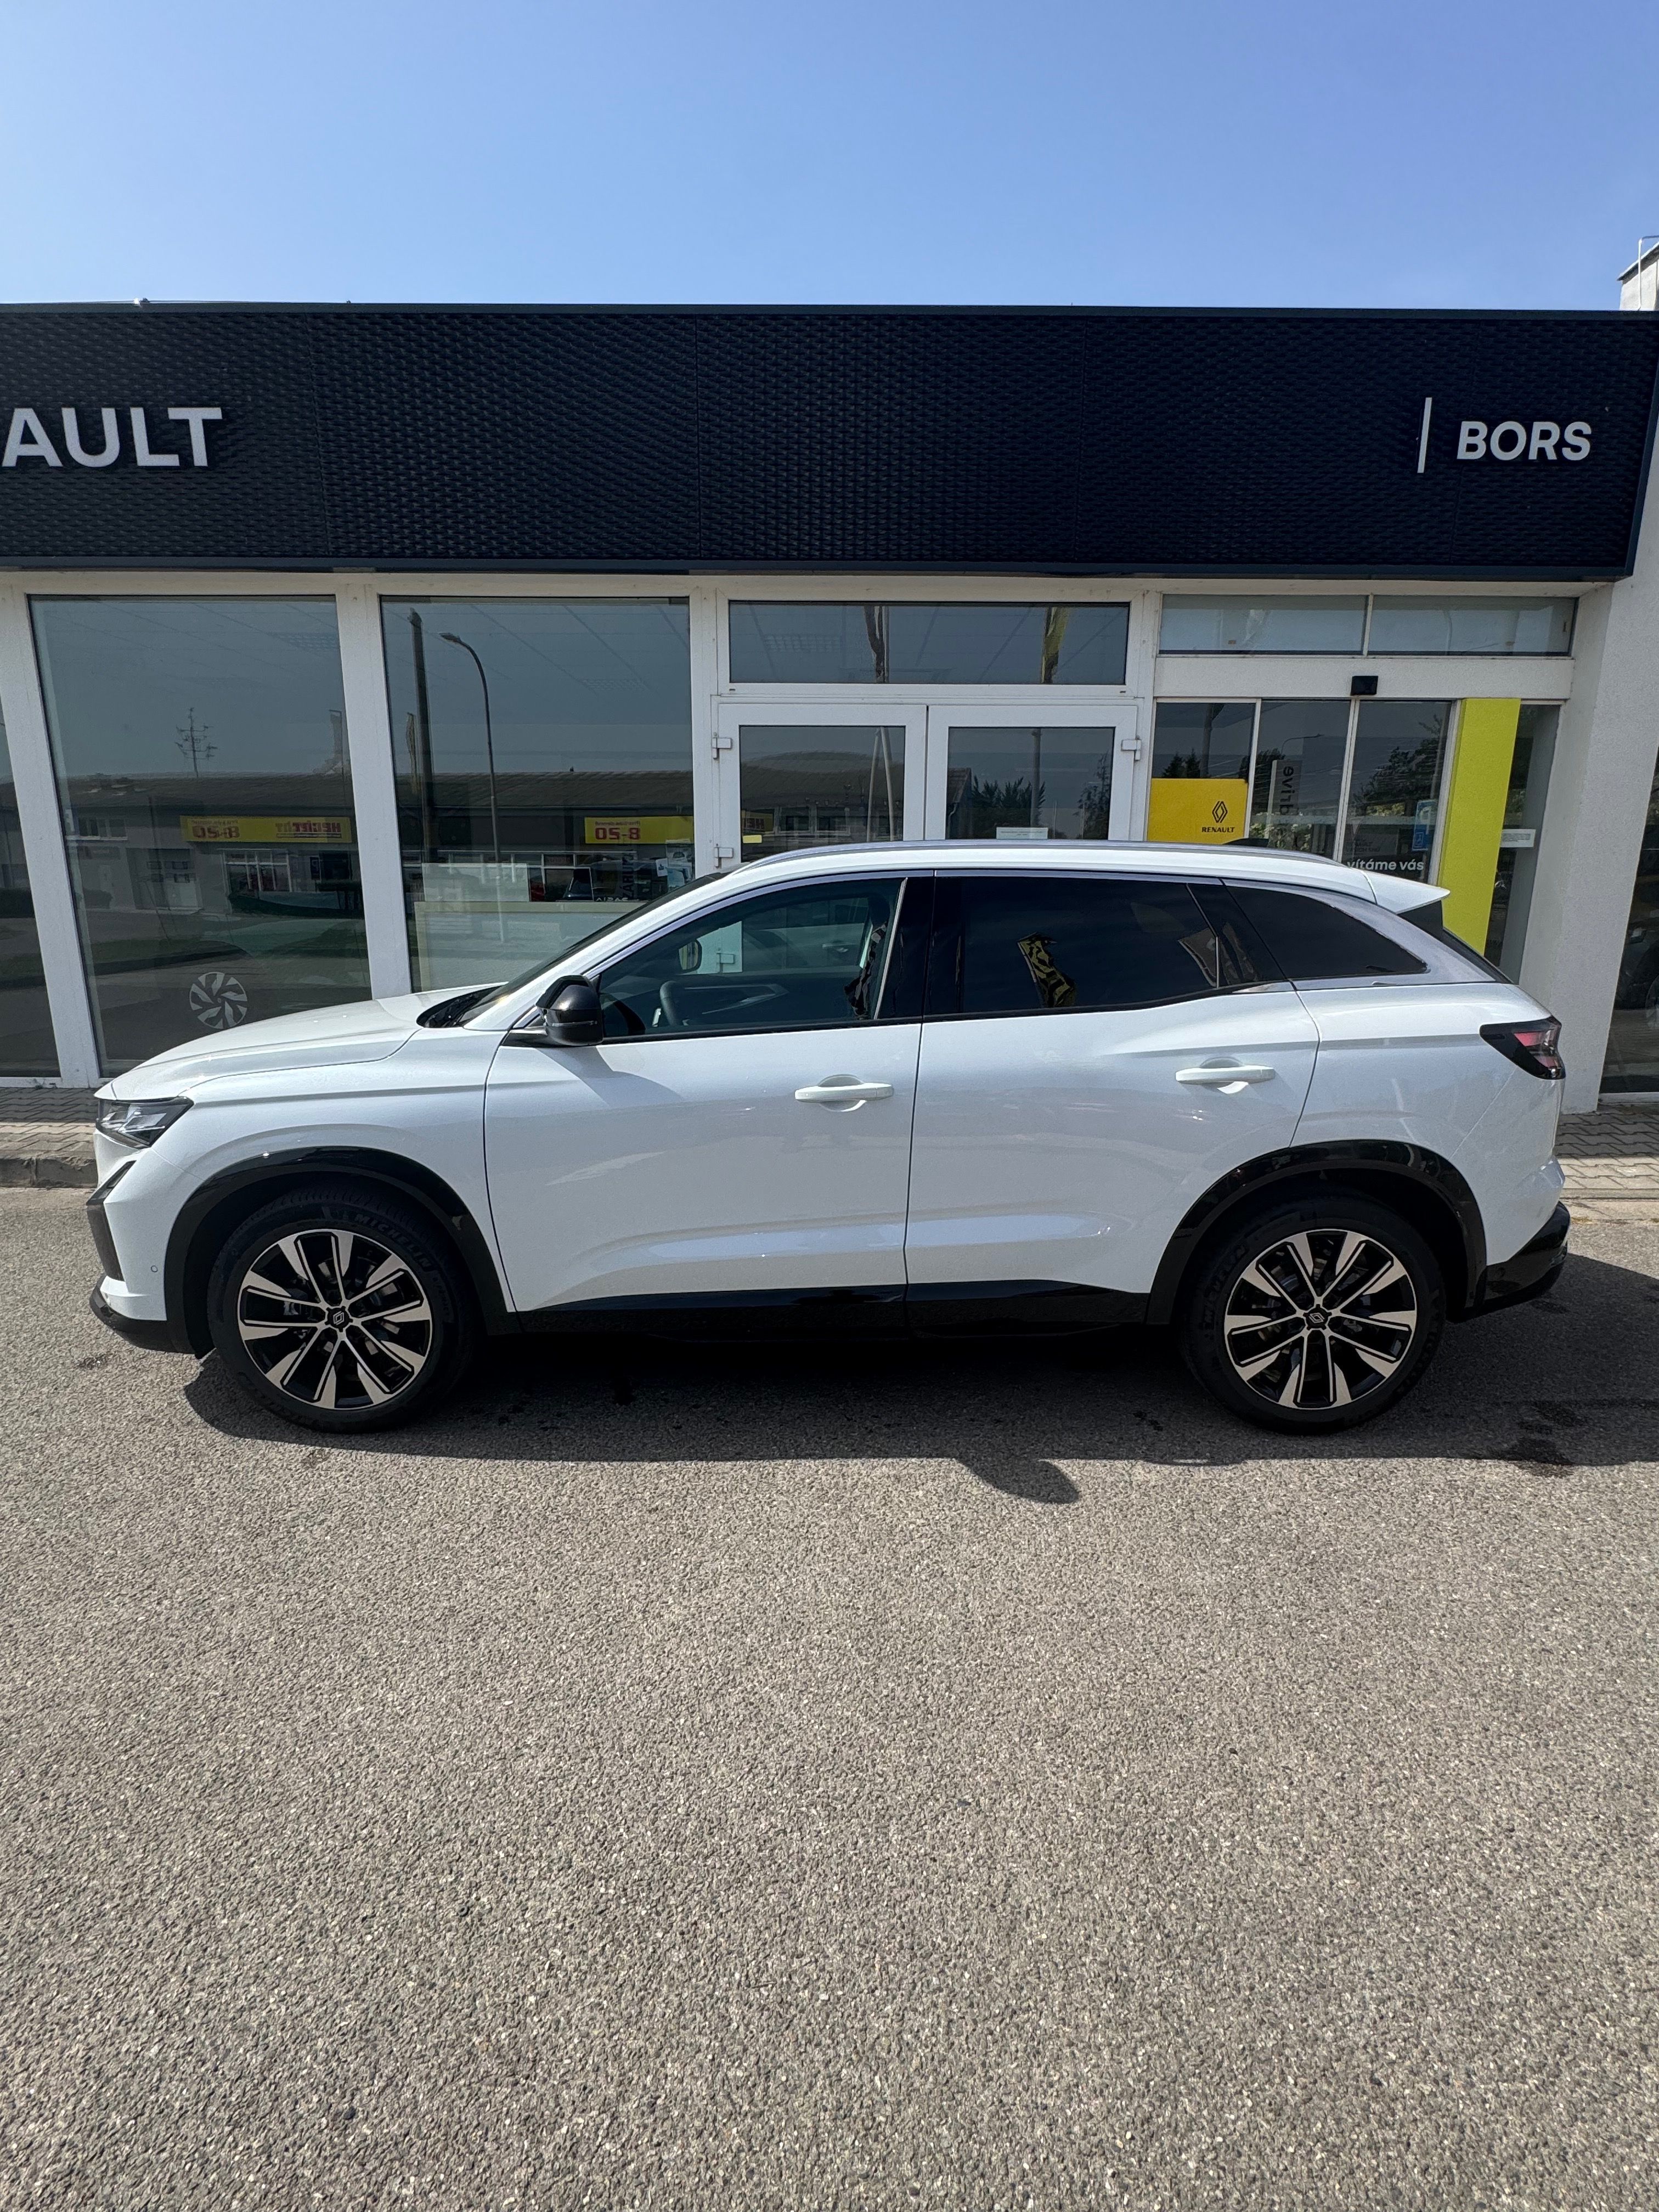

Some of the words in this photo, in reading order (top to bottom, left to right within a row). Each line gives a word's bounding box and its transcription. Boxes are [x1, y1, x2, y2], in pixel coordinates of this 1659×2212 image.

[2, 408, 222, 467] AULT
[1457, 421, 1592, 461] BORS
[1347, 859, 1397, 871] vítáme
[1400, 858, 1424, 871] vás
